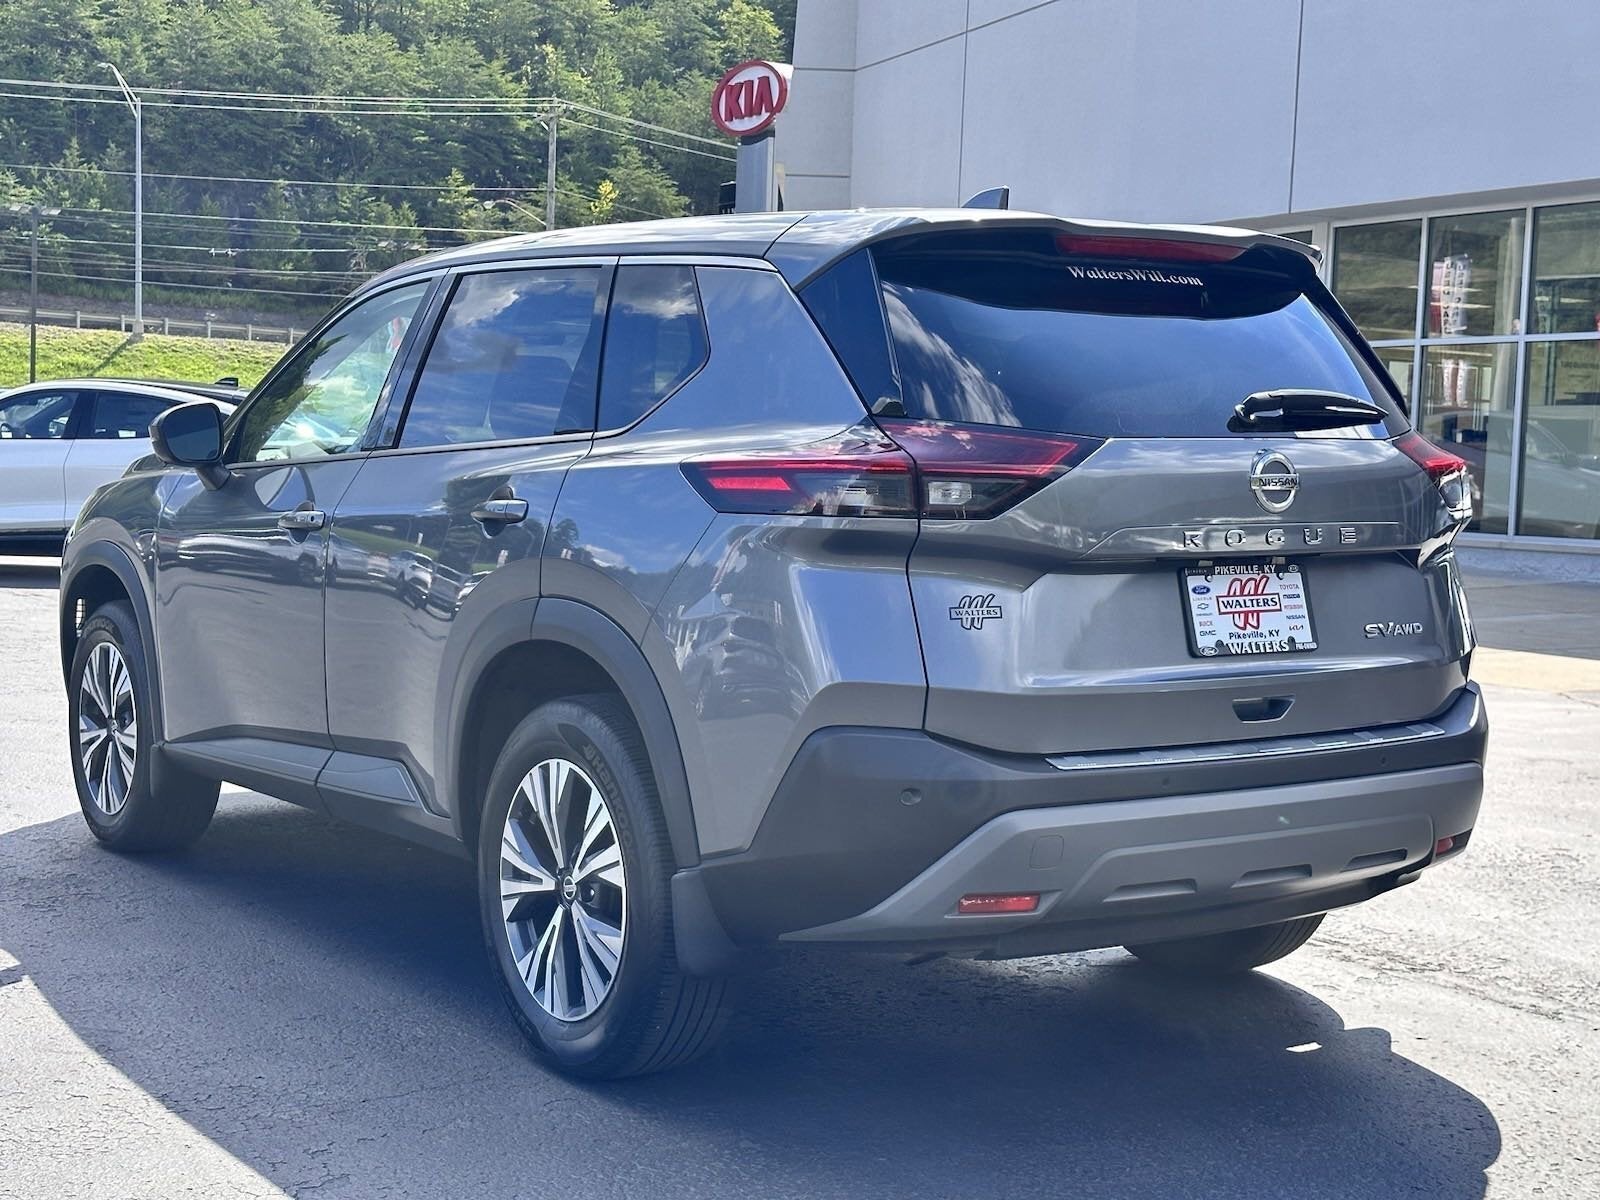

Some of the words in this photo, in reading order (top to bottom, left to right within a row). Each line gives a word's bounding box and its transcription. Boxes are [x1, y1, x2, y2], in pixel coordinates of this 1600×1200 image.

[724, 76, 774, 121] KIA
[1066, 265, 1204, 286] WaltersWill.com
[1259, 477, 1298, 487] NISSAN
[1183, 527, 1358, 548] ROGUE
[1214, 565, 1261, 575] PIKEVILLE,
[1264, 565, 1276, 573] KY
[1221, 598, 1278, 609] WALTERS
[1229, 631, 1267, 639] Pikeville,
[1364, 621, 1394, 639] SV
[1393, 622, 1423, 636] AWD
[1226, 640, 1289, 654] WALTERS
